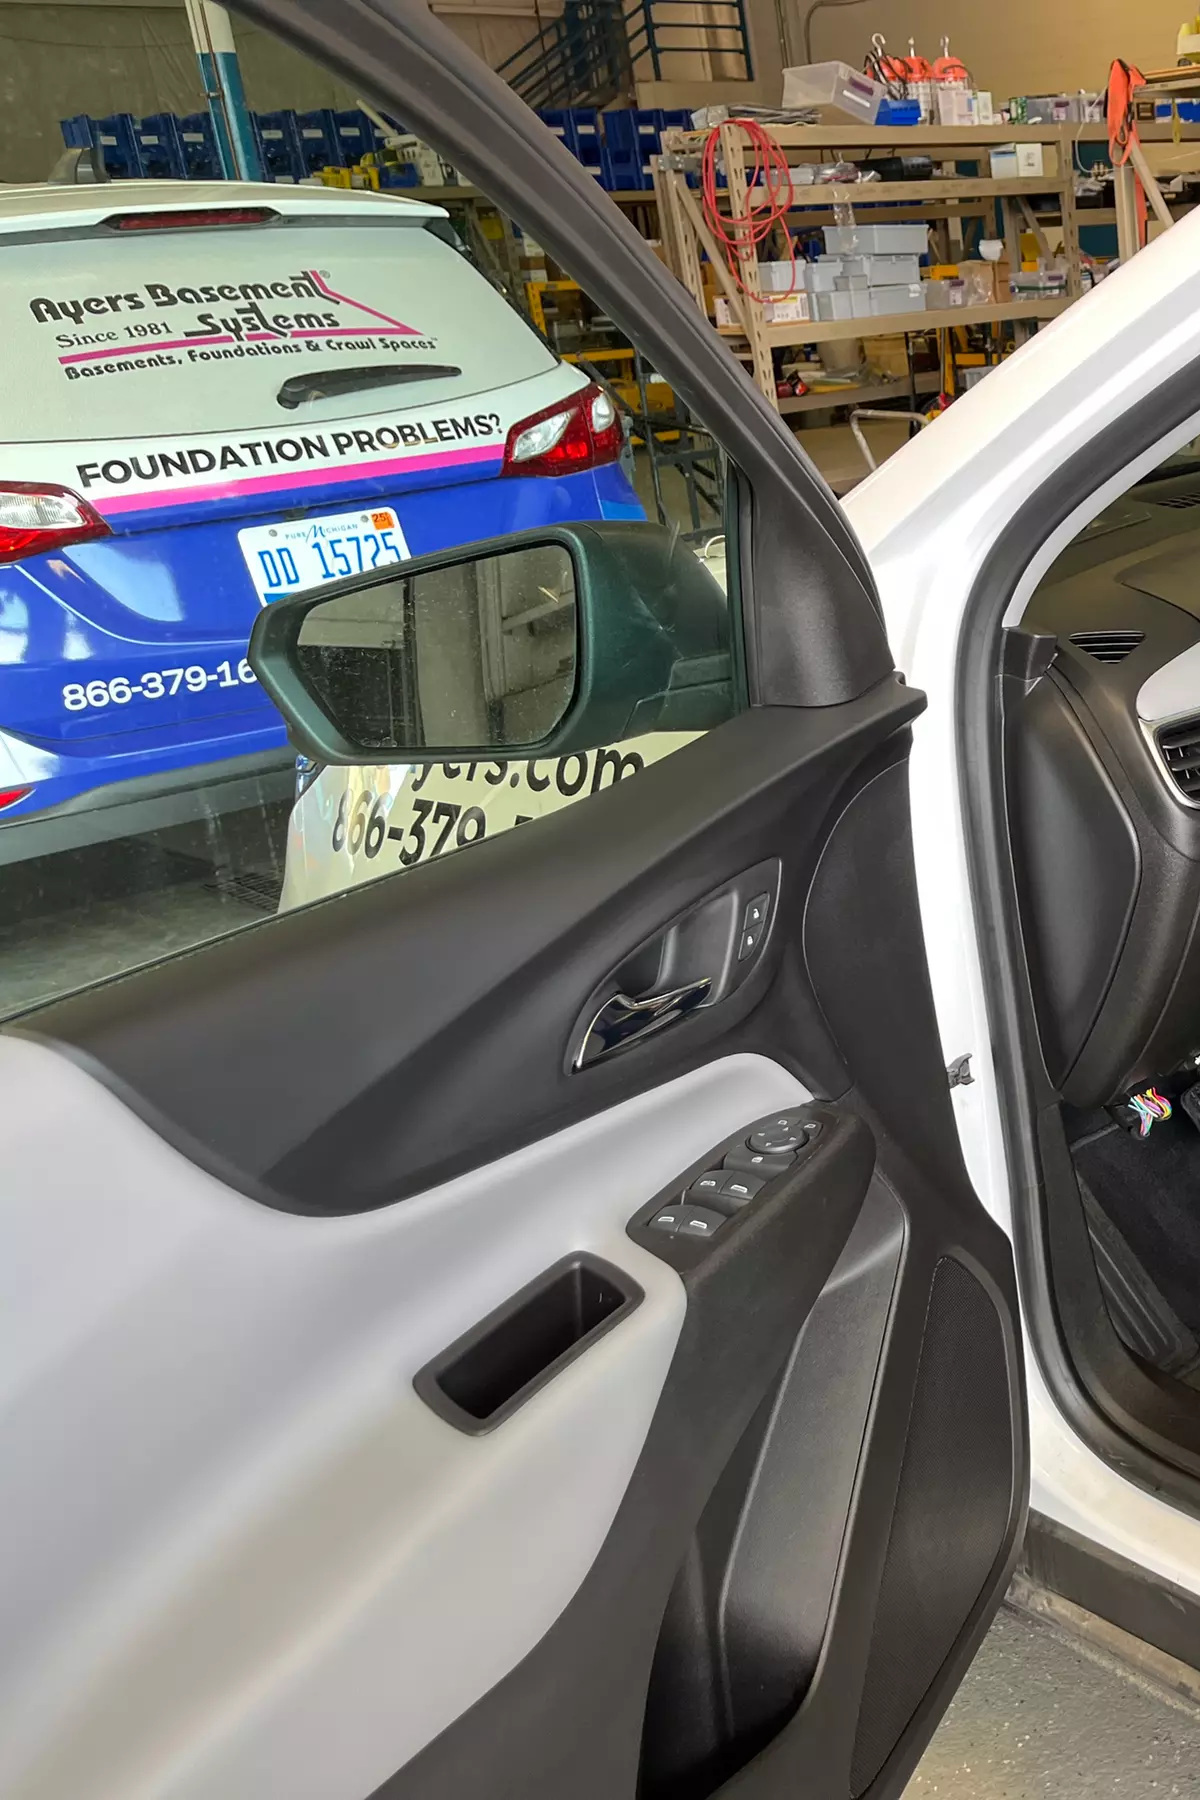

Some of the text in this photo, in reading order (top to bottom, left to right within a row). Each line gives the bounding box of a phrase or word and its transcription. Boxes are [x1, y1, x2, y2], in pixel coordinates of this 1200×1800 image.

[30, 271, 341, 325] Ayers Basement
[56, 321, 173, 350] Since 1981
[184, 302, 341, 342] Systems
[65, 354, 184, 381] Basements,
[188, 340, 302, 364] Foundations
[306, 339, 322, 353] &
[327, 336, 376, 352] Crawl
[76, 412, 504, 488] FOUNDATION PROBLEMS?
[285, 524, 359, 544] PURE MICHIGAN
[258, 532, 402, 588] DD 15725
